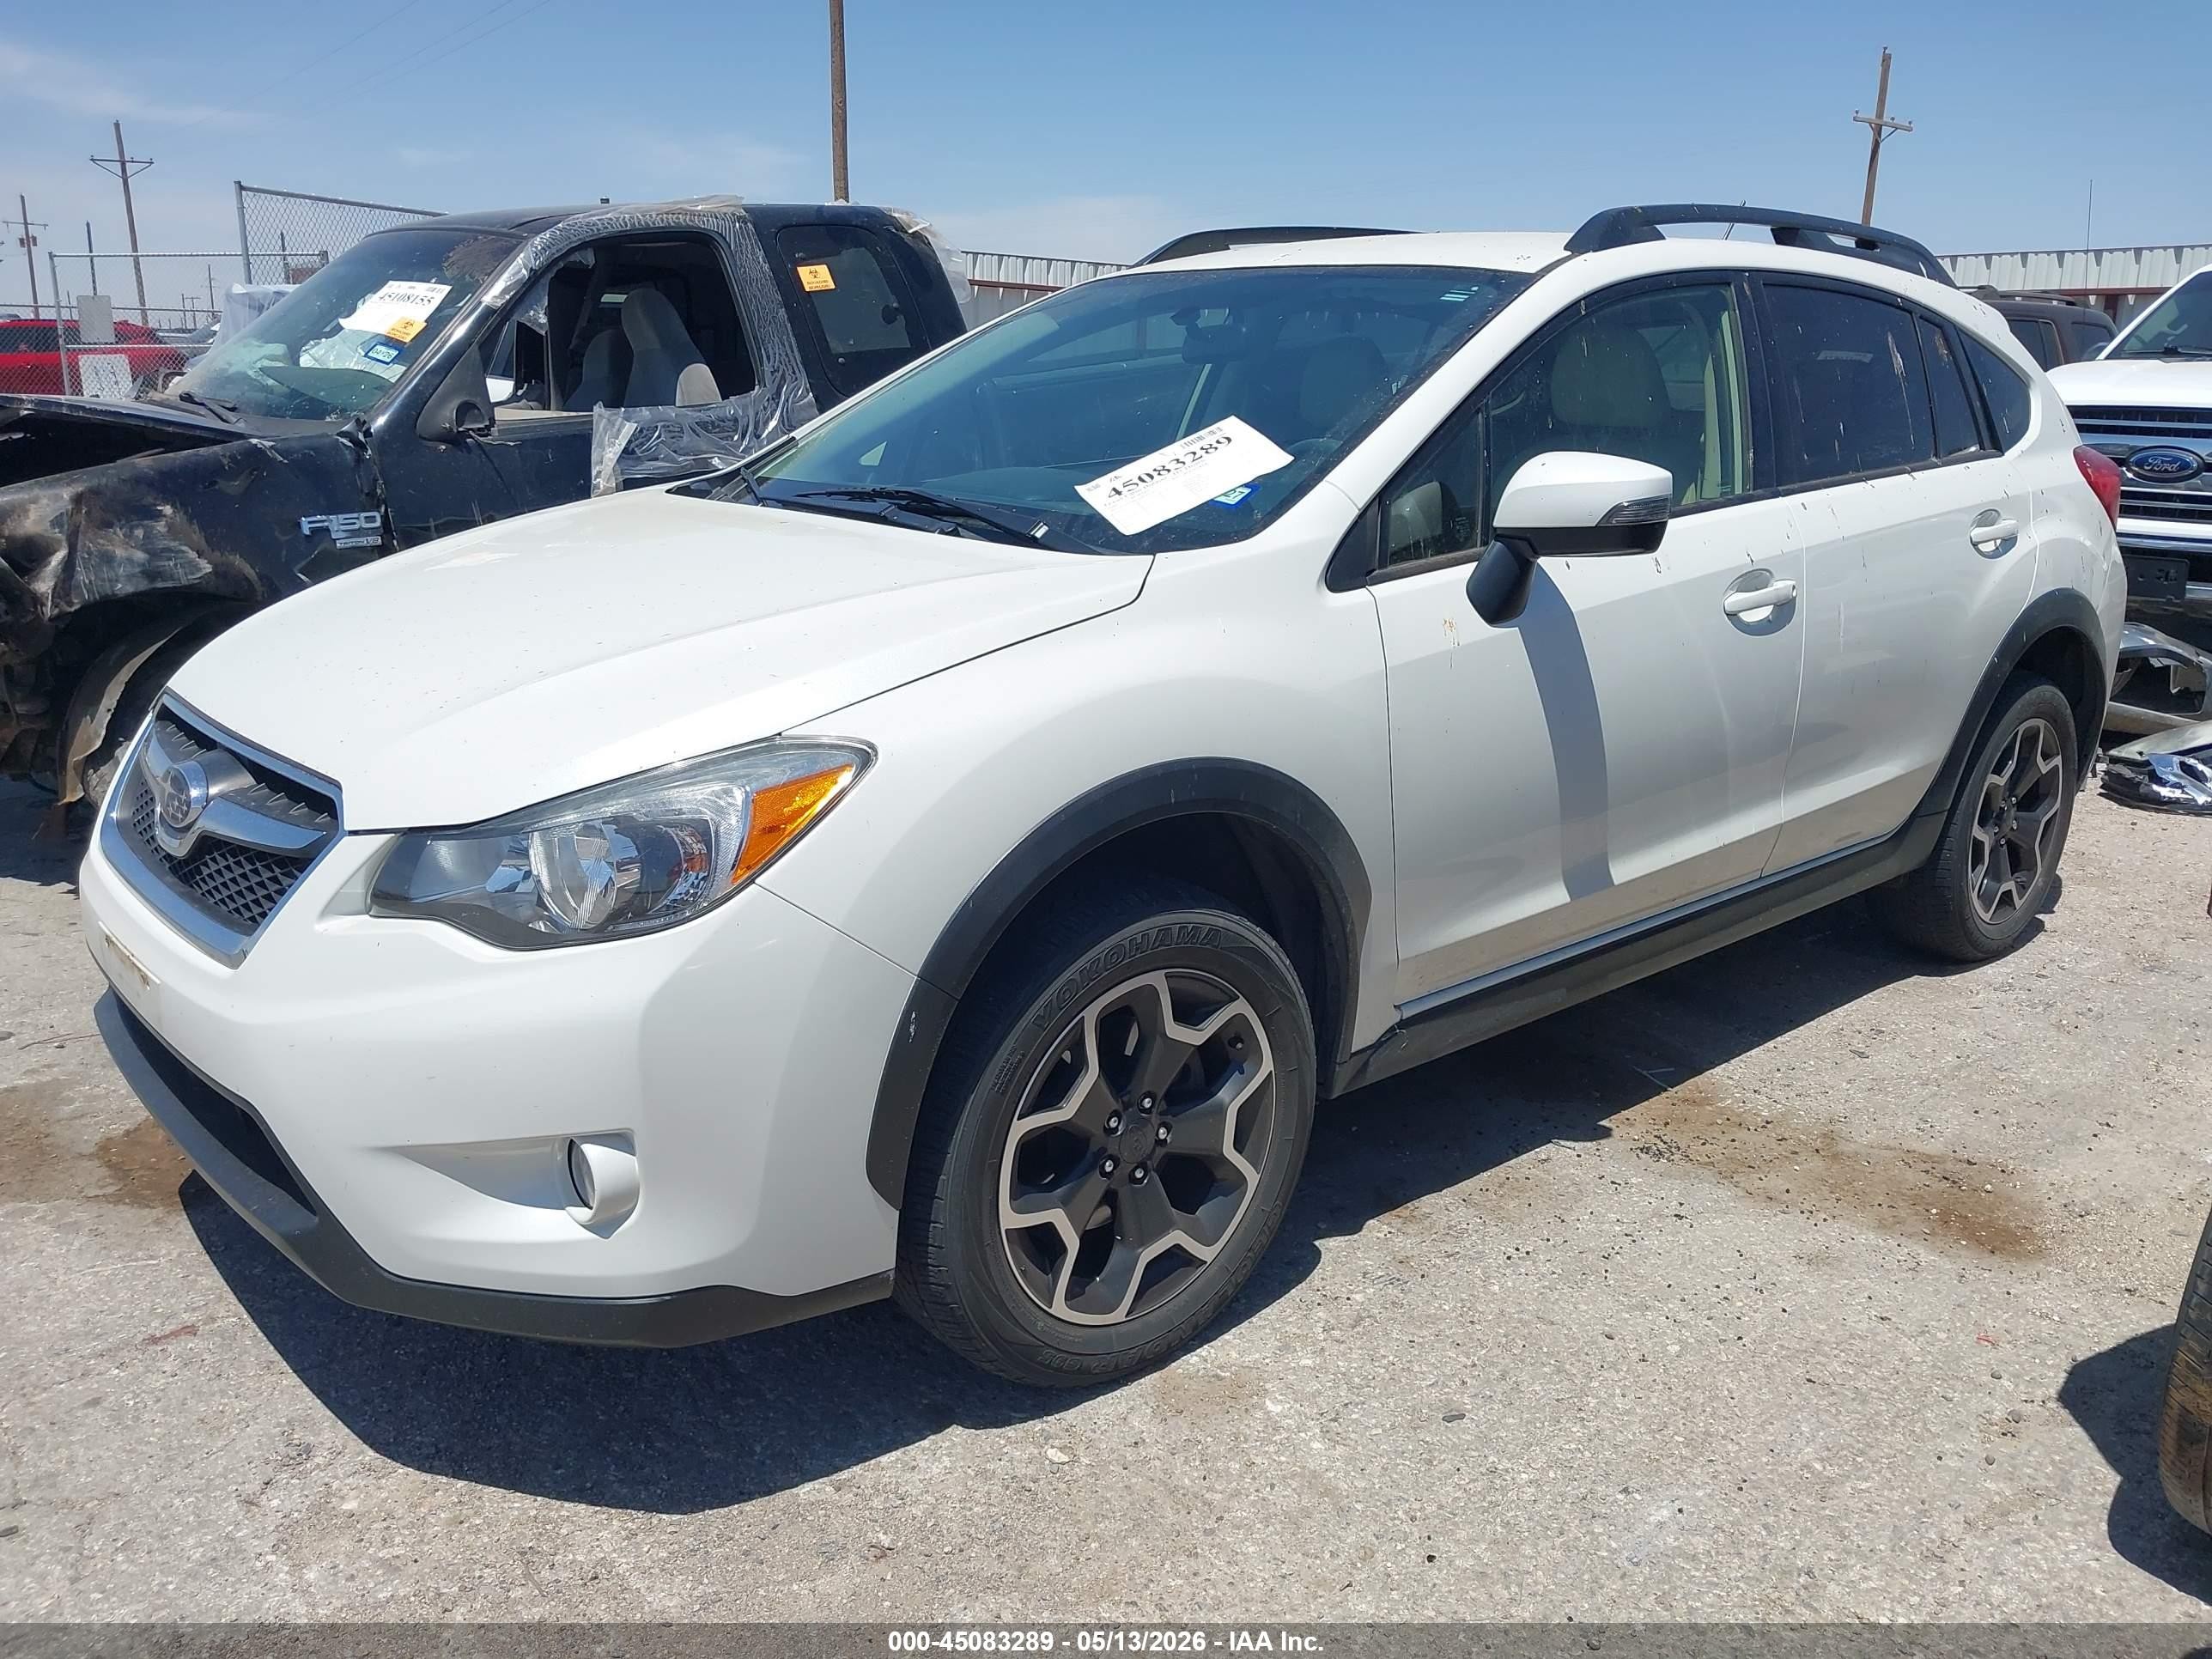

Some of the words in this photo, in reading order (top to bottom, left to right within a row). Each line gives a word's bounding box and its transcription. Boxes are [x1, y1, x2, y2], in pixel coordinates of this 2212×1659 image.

[378, 292, 435, 307] 45108155
[1108, 434, 1233, 498] 45083289
[2144, 457, 2181, 472] Ford
[1030, 923, 1223, 1030] YOKOHAMA
